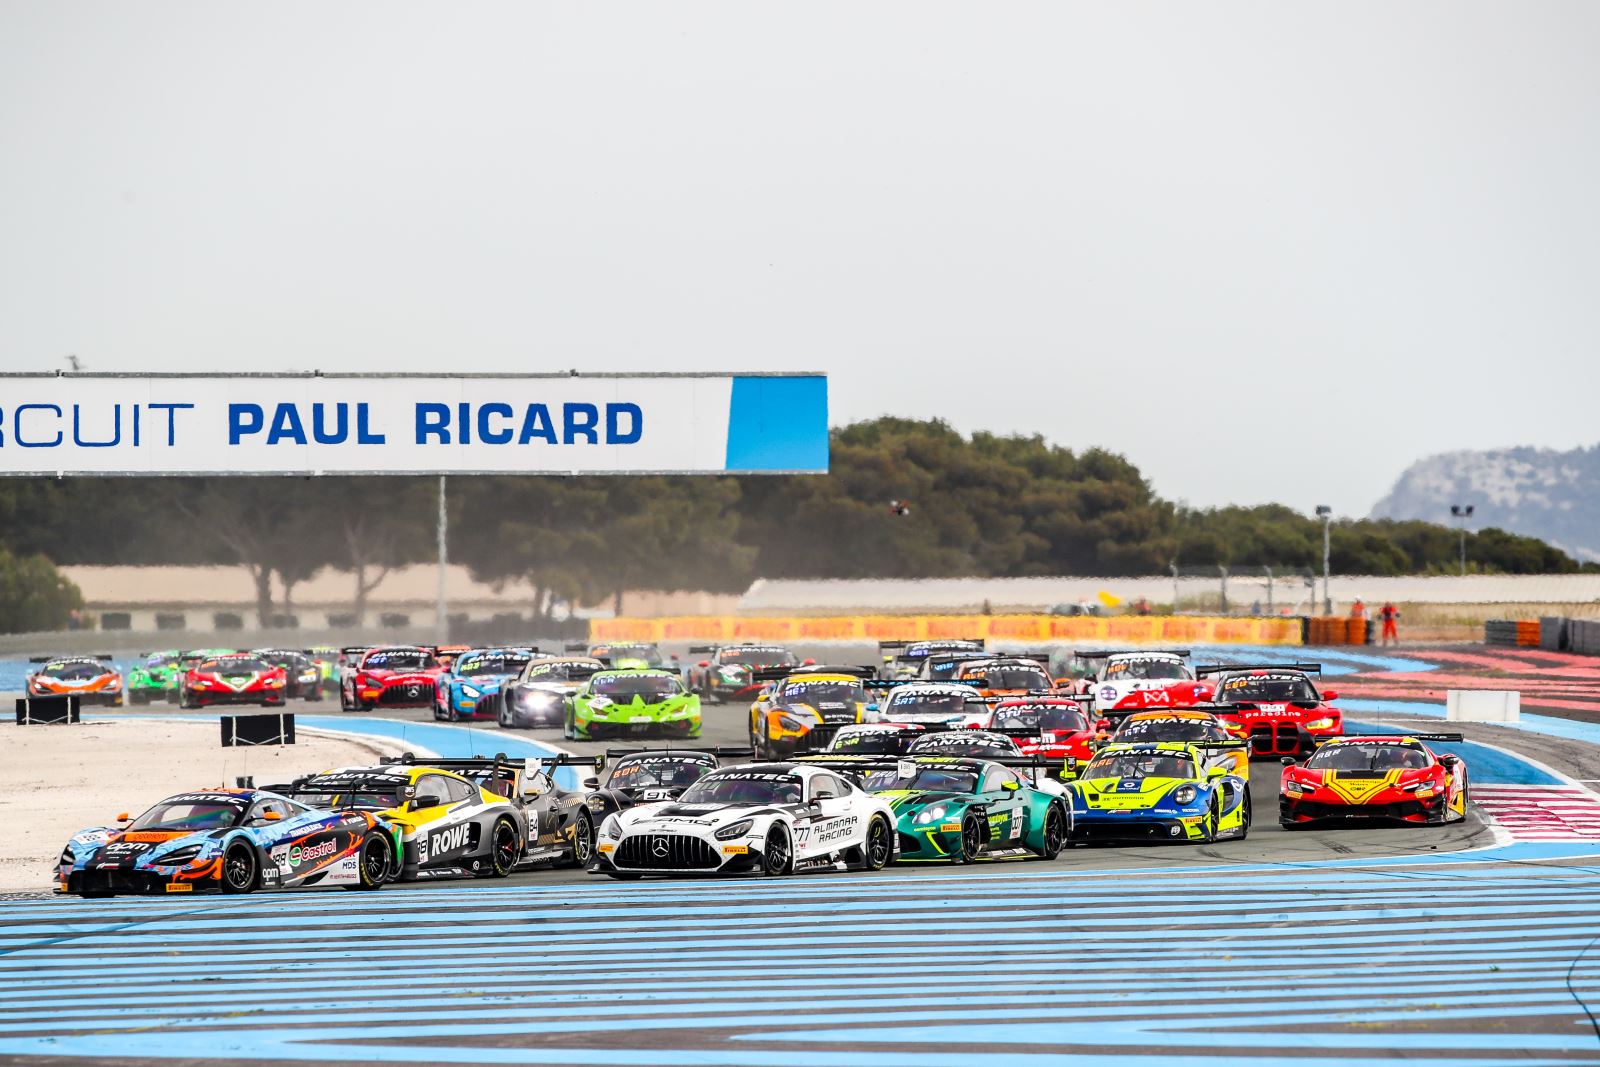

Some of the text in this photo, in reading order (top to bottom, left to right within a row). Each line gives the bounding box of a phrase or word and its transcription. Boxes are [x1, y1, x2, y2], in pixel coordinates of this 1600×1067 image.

[0, 402, 644, 448] CUIT PAUL RICARD
[1225, 674, 1306, 684] FANATEC
[996, 705, 1079, 715] FANATEC
[1129, 718, 1215, 729] FANATEC
[915, 739, 1006, 751] FANATEC
[1100, 750, 1192, 759] FANATEC
[617, 757, 713, 770] FANATEC
[311, 773, 409, 783] FANATEC
[702, 773, 796, 783] FANATEC
[646, 791, 667, 800] 91
[814, 815, 859, 835] ALMANAR
[431, 822, 471, 857] ROWE
[819, 826, 853, 844] RACING
[301, 837, 337, 861] Castrol
